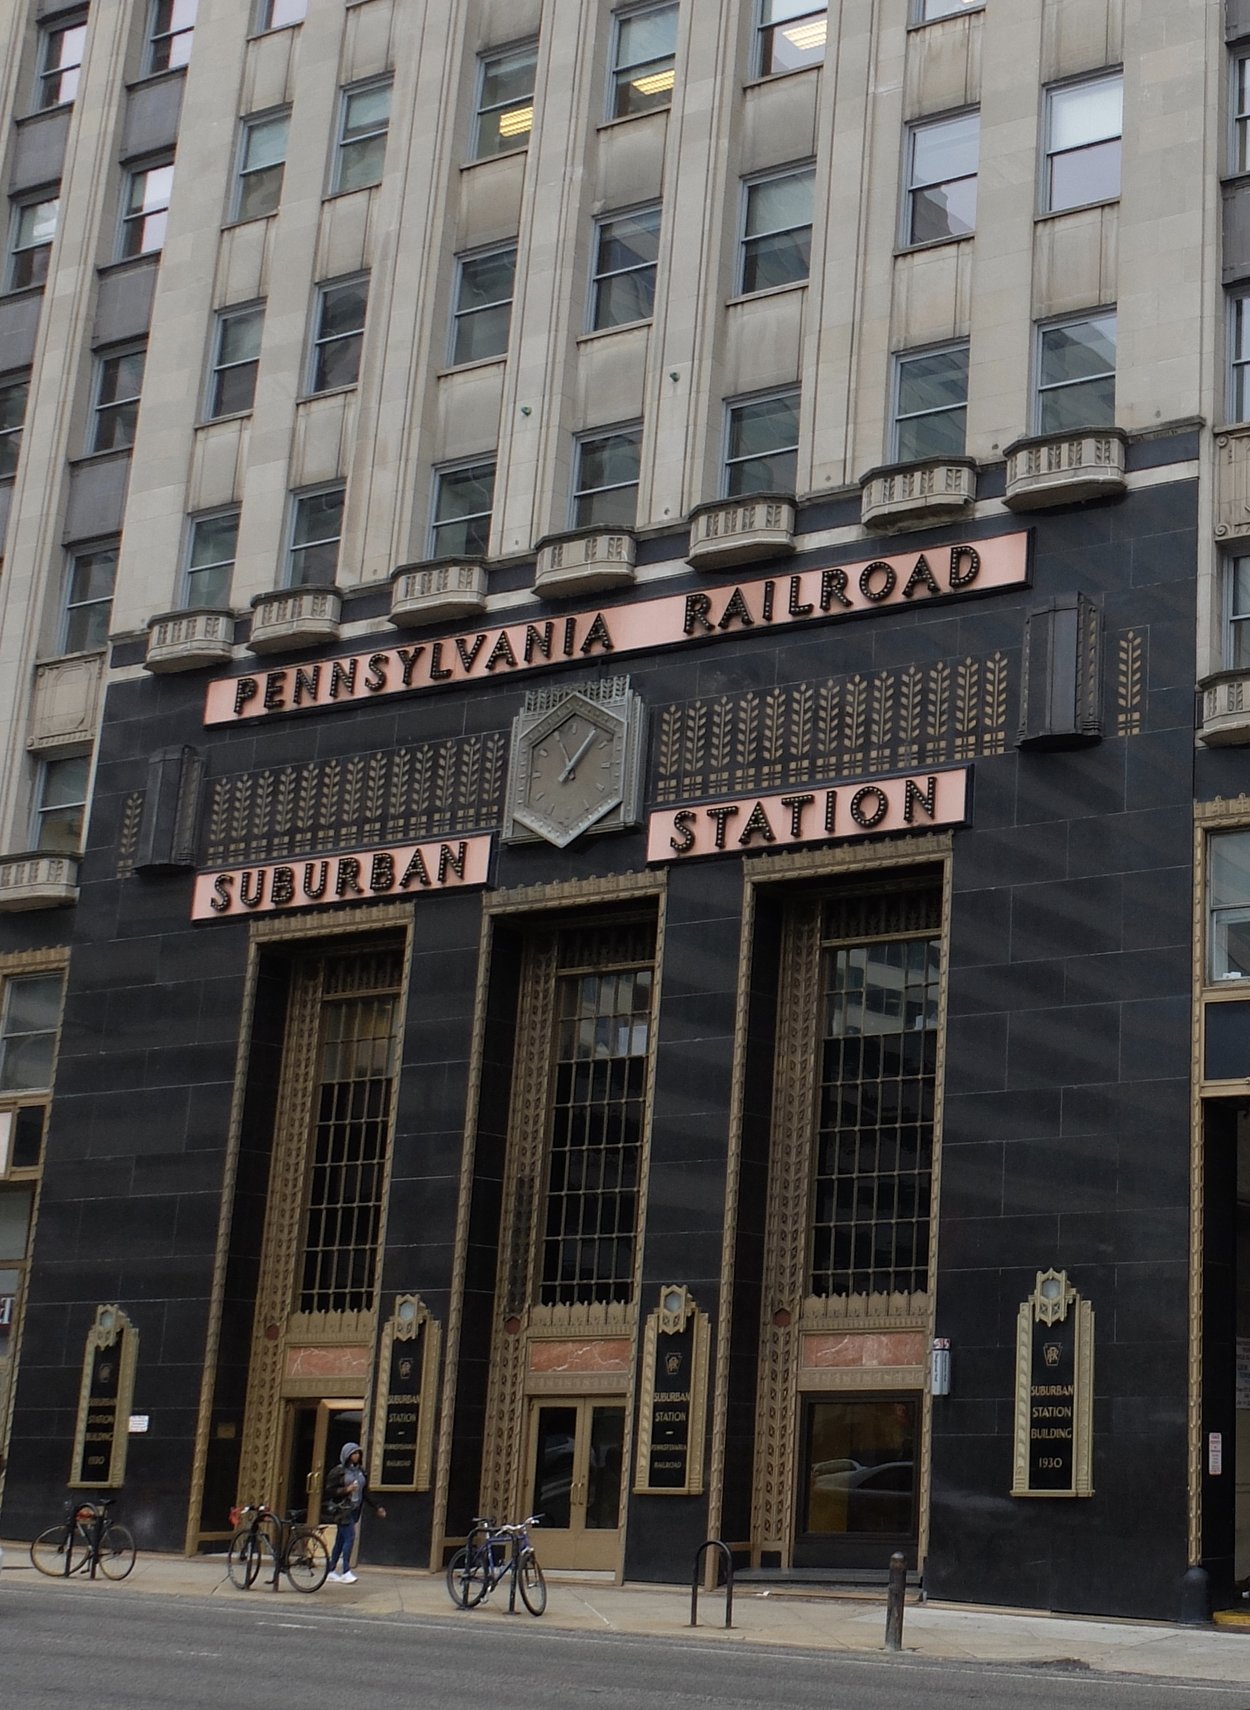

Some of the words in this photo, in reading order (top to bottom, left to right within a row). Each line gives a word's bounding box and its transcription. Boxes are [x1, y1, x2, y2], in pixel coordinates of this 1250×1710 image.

[232, 611, 615, 715] PENNSYLVANIA
[682, 544, 981, 635] RAILROAD
[669, 776, 937, 853] STATION
[210, 841, 469, 912] SUBURBAN
[653, 1391, 691, 1402] SUBURBAN
[1031, 1384, 1074, 1397] SUBURBAN
[655, 1411, 687, 1422] STATION
[1032, 1405, 1072, 1418] STATION
[1030, 1427, 1072, 1439] BUILDING
[1039, 1456, 1063, 1469] 1930
